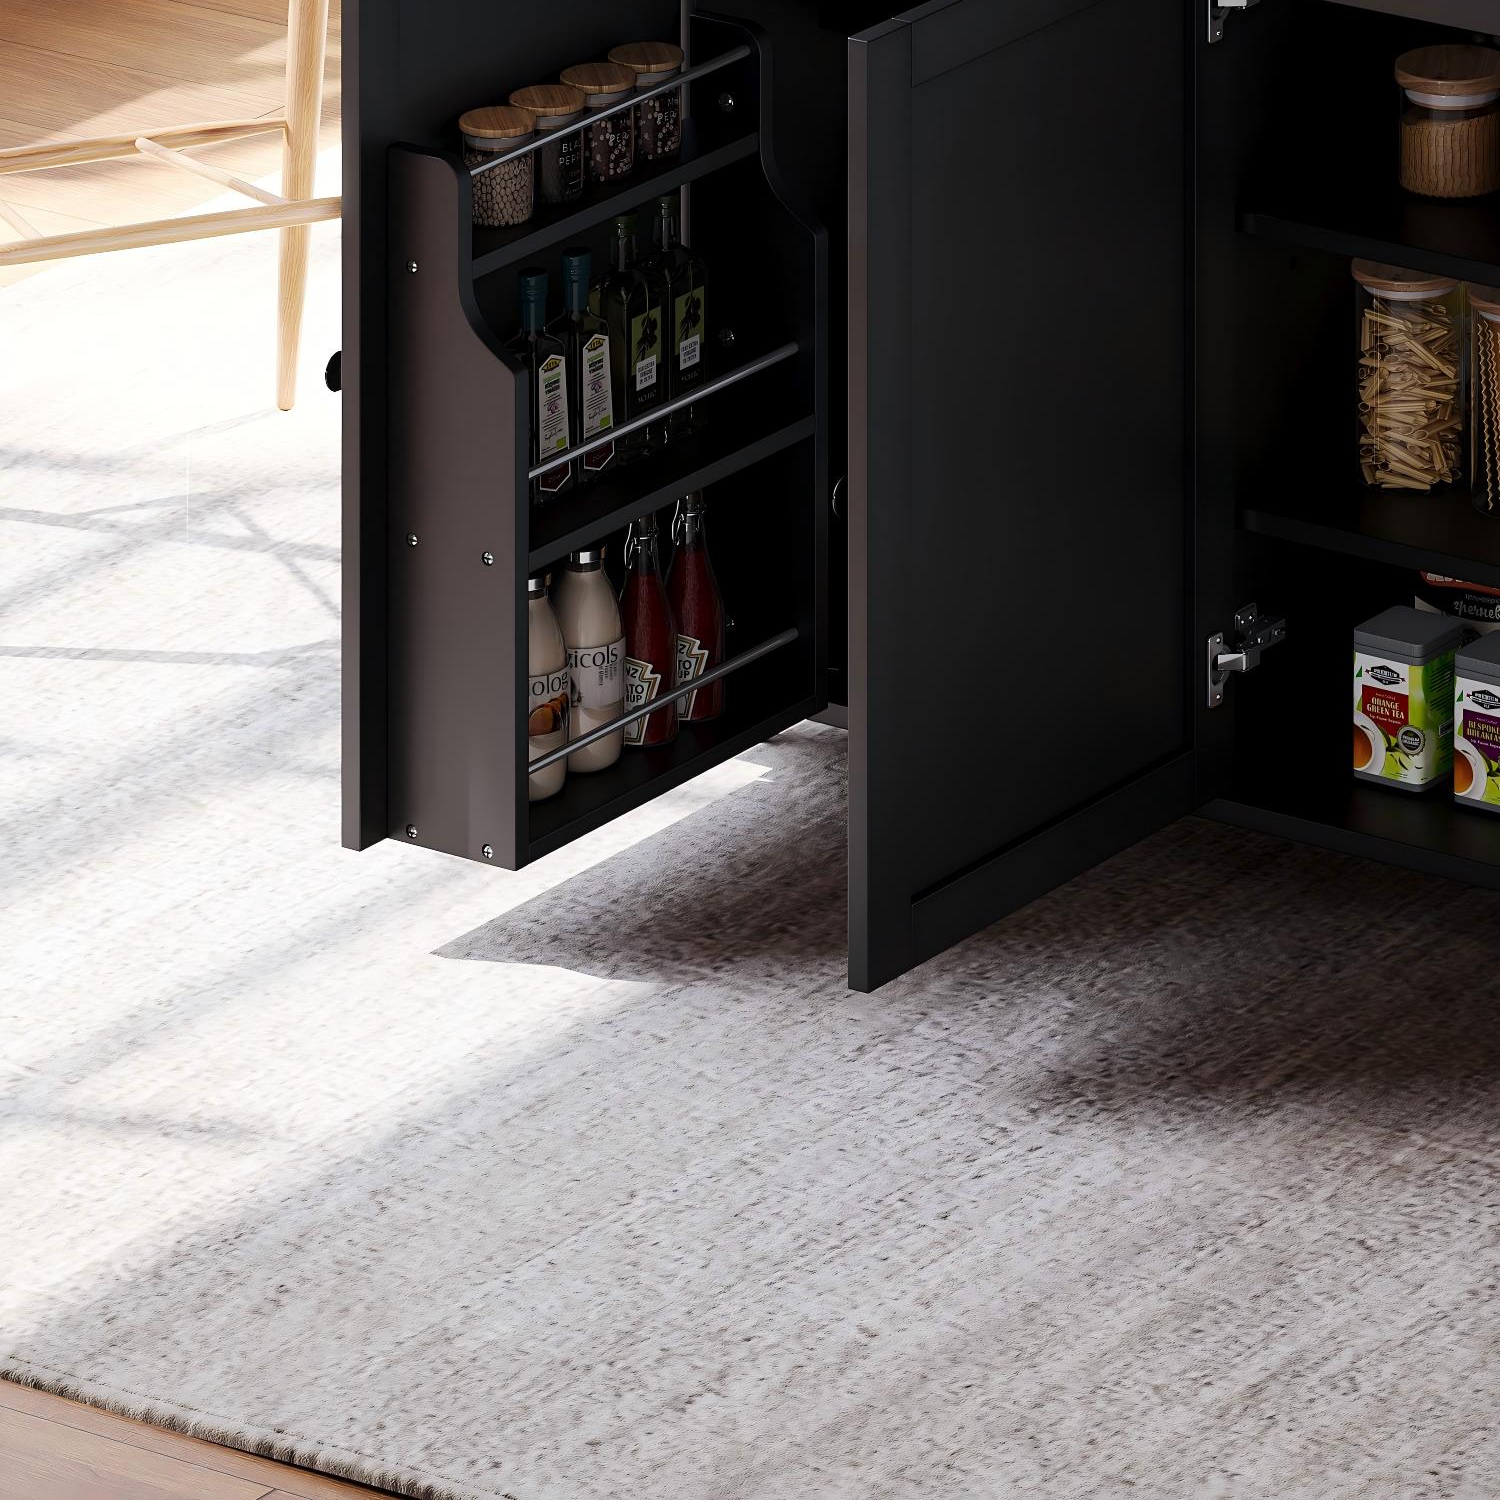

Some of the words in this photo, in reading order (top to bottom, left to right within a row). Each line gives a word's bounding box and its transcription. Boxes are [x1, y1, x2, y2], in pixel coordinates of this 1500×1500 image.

[1373, 668, 1398, 678] PREMIUM
[1371, 696, 1400, 710] ORANGE
[1474, 692, 1499, 702] PREMIUM
[1366, 703, 1390, 716] GREEN
[1392, 709, 1405, 720] TEA
